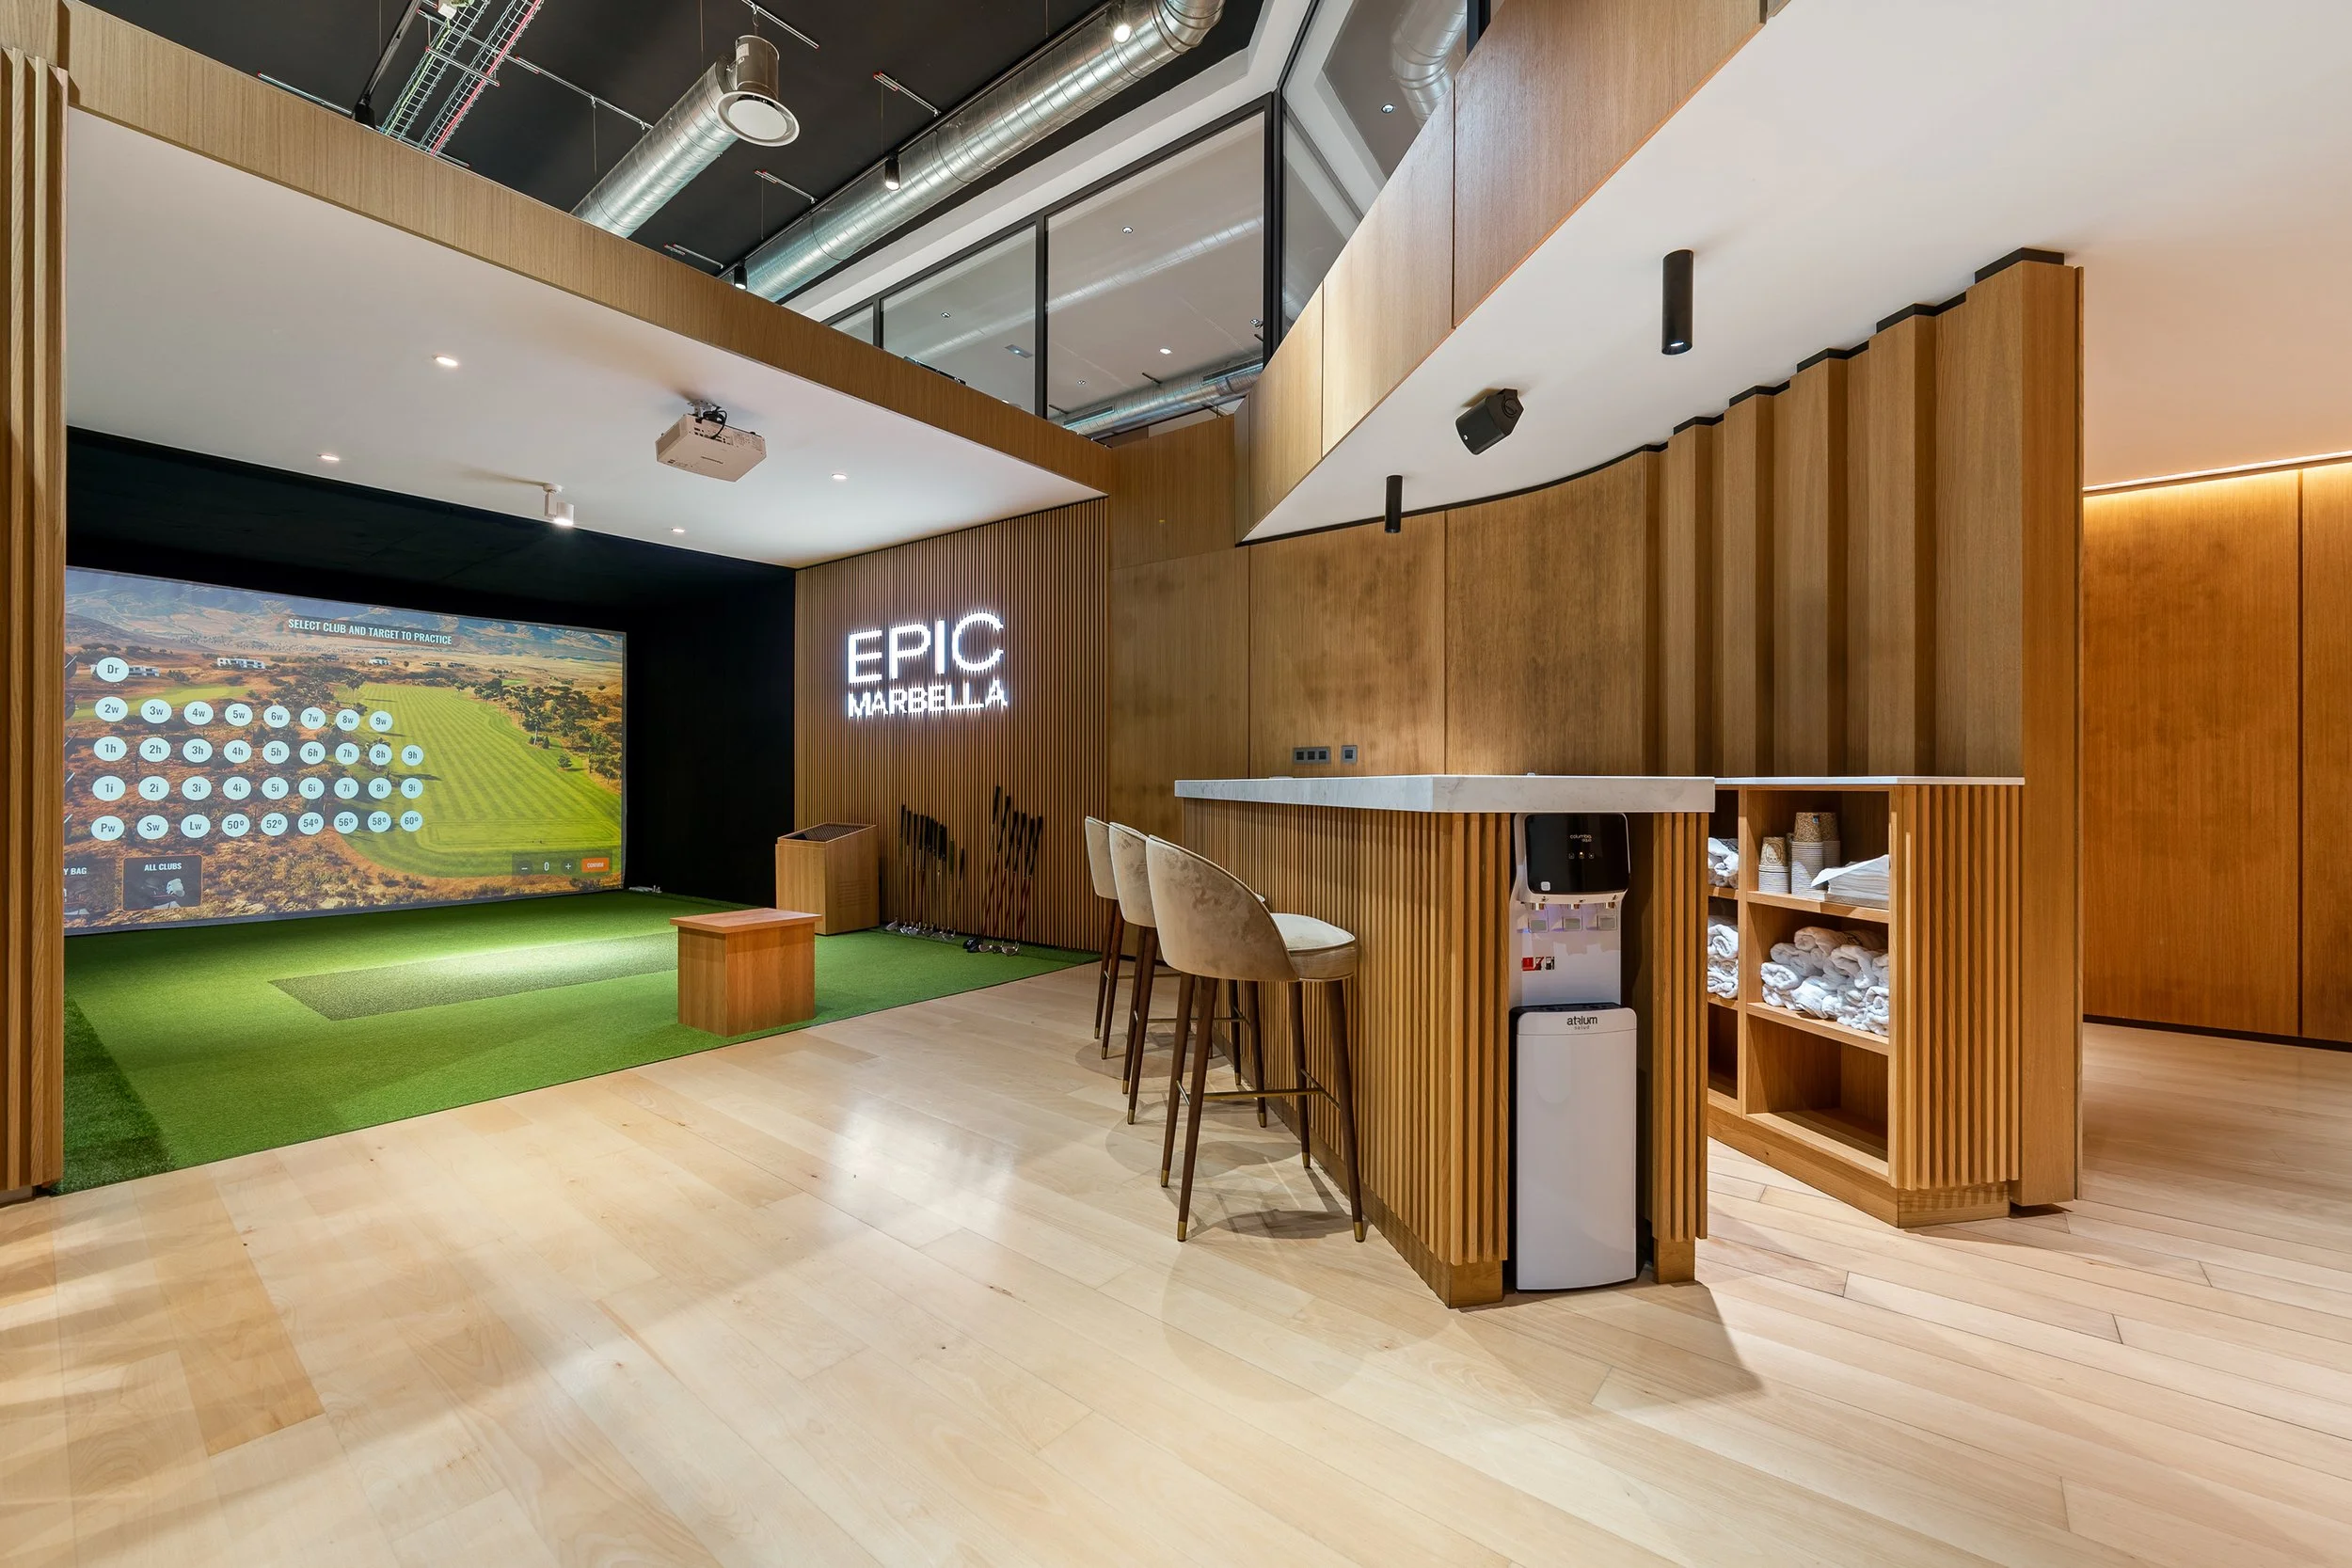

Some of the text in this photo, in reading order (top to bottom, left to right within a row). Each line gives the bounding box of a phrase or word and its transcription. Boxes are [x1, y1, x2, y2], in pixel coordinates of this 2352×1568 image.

[288, 618, 453, 645] SELECT CLUB AND TARGET TO PRACTICE
[848, 612, 1004, 684] EPIC
[107, 665, 119, 674] Dr
[848, 680, 1008, 718] MARBELLA
[105, 705, 387, 725] 2w 3w 4w 5w 6w 7w 8w 9w
[105, 744, 418, 760] 1h 2h 3h 4h 5h 6h 7h 8h 9h
[105, 784, 416, 793] 1i 2i 3i 4i 5i 6i 7i 8i 9i
[101, 823, 116, 832] Pw
[147, 822, 161, 832] Sw
[190, 822, 202, 831] Lw
[71, 867, 87, 876] BAG
[158, 863, 183, 871] CLUBS
